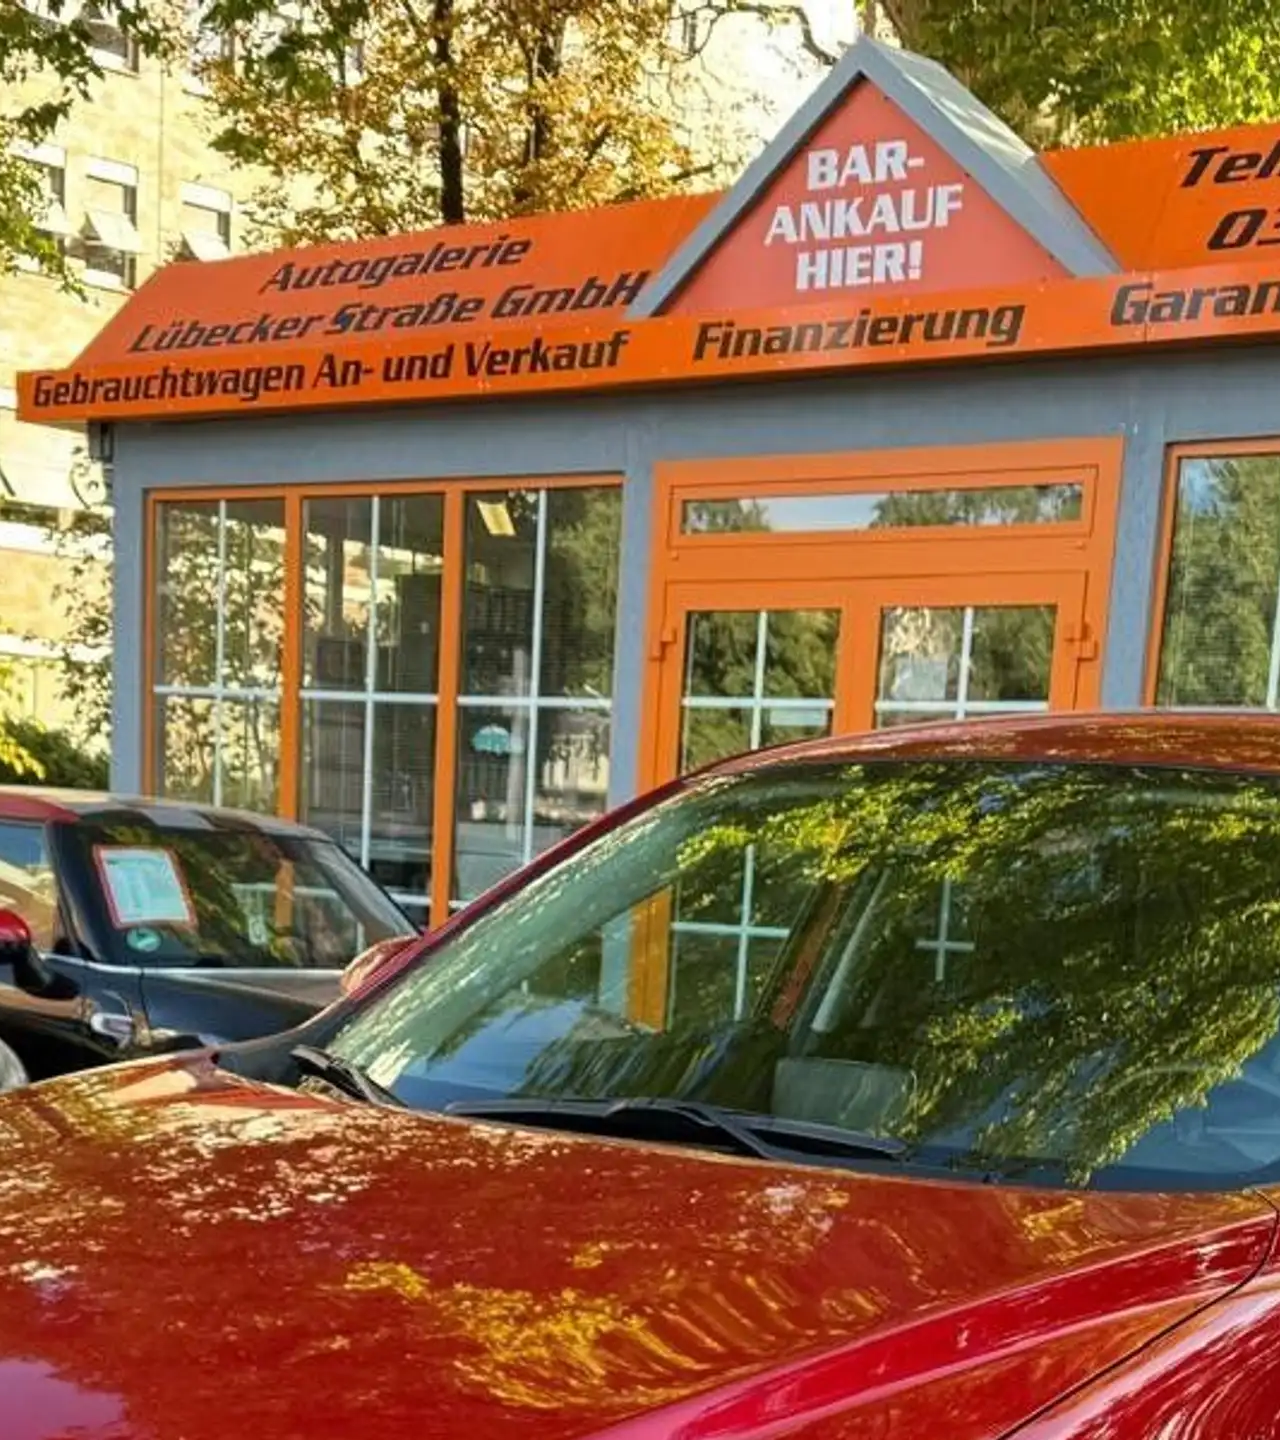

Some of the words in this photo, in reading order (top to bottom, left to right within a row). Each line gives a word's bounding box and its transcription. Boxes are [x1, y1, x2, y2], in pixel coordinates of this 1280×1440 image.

[806, 140, 925, 191] BAR-
[764, 183, 964, 246] ANKAUF
[259, 234, 532, 294] Autogalerie
[795, 240, 922, 291] HIER!
[128, 312, 324, 354] Lübecker
[330, 293, 484, 335] Straße
[491, 270, 652, 319] GmbH
[692, 304, 1026, 361] Finanzierung
[33, 359, 305, 409] Gebrauchtwagen
[313, 352, 374, 388] An-
[382, 343, 455, 382] und
[462, 331, 630, 377] Verkauf
